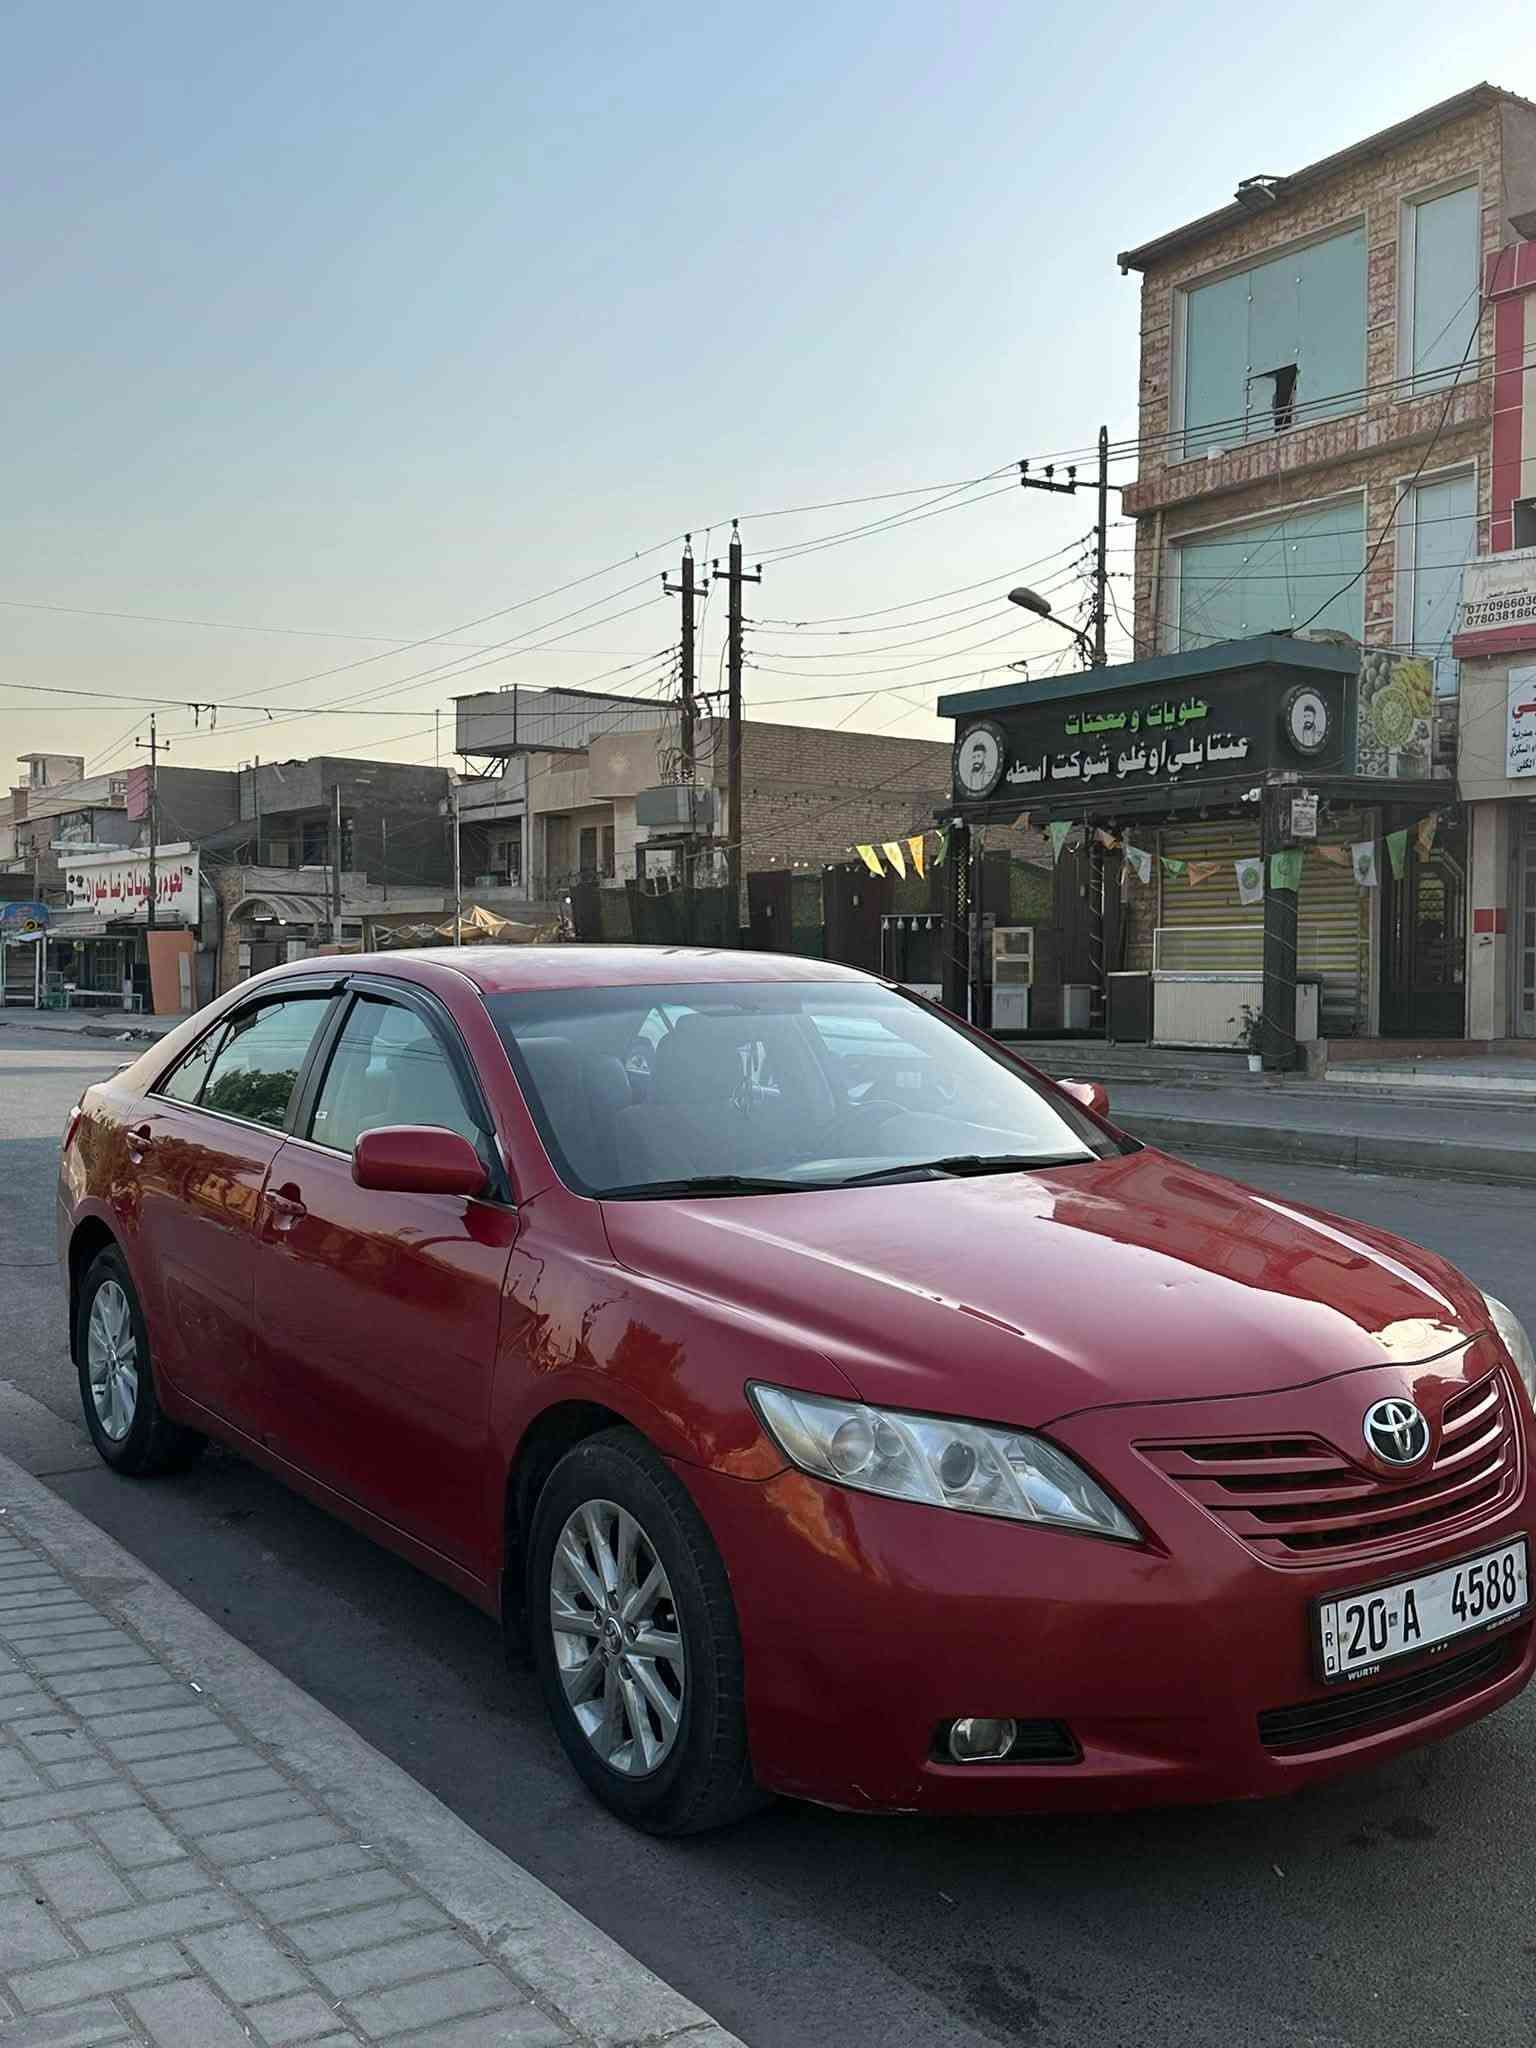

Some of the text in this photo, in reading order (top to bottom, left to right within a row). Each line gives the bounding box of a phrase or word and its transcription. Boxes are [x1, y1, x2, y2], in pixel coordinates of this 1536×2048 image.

[1147, 697, 1208, 730] حلويات
[1051, 743, 1110, 782] شوكت
[1116, 739, 1167, 779] اوغلو
[1346, 1553, 1516, 1660] 20 A 4588
